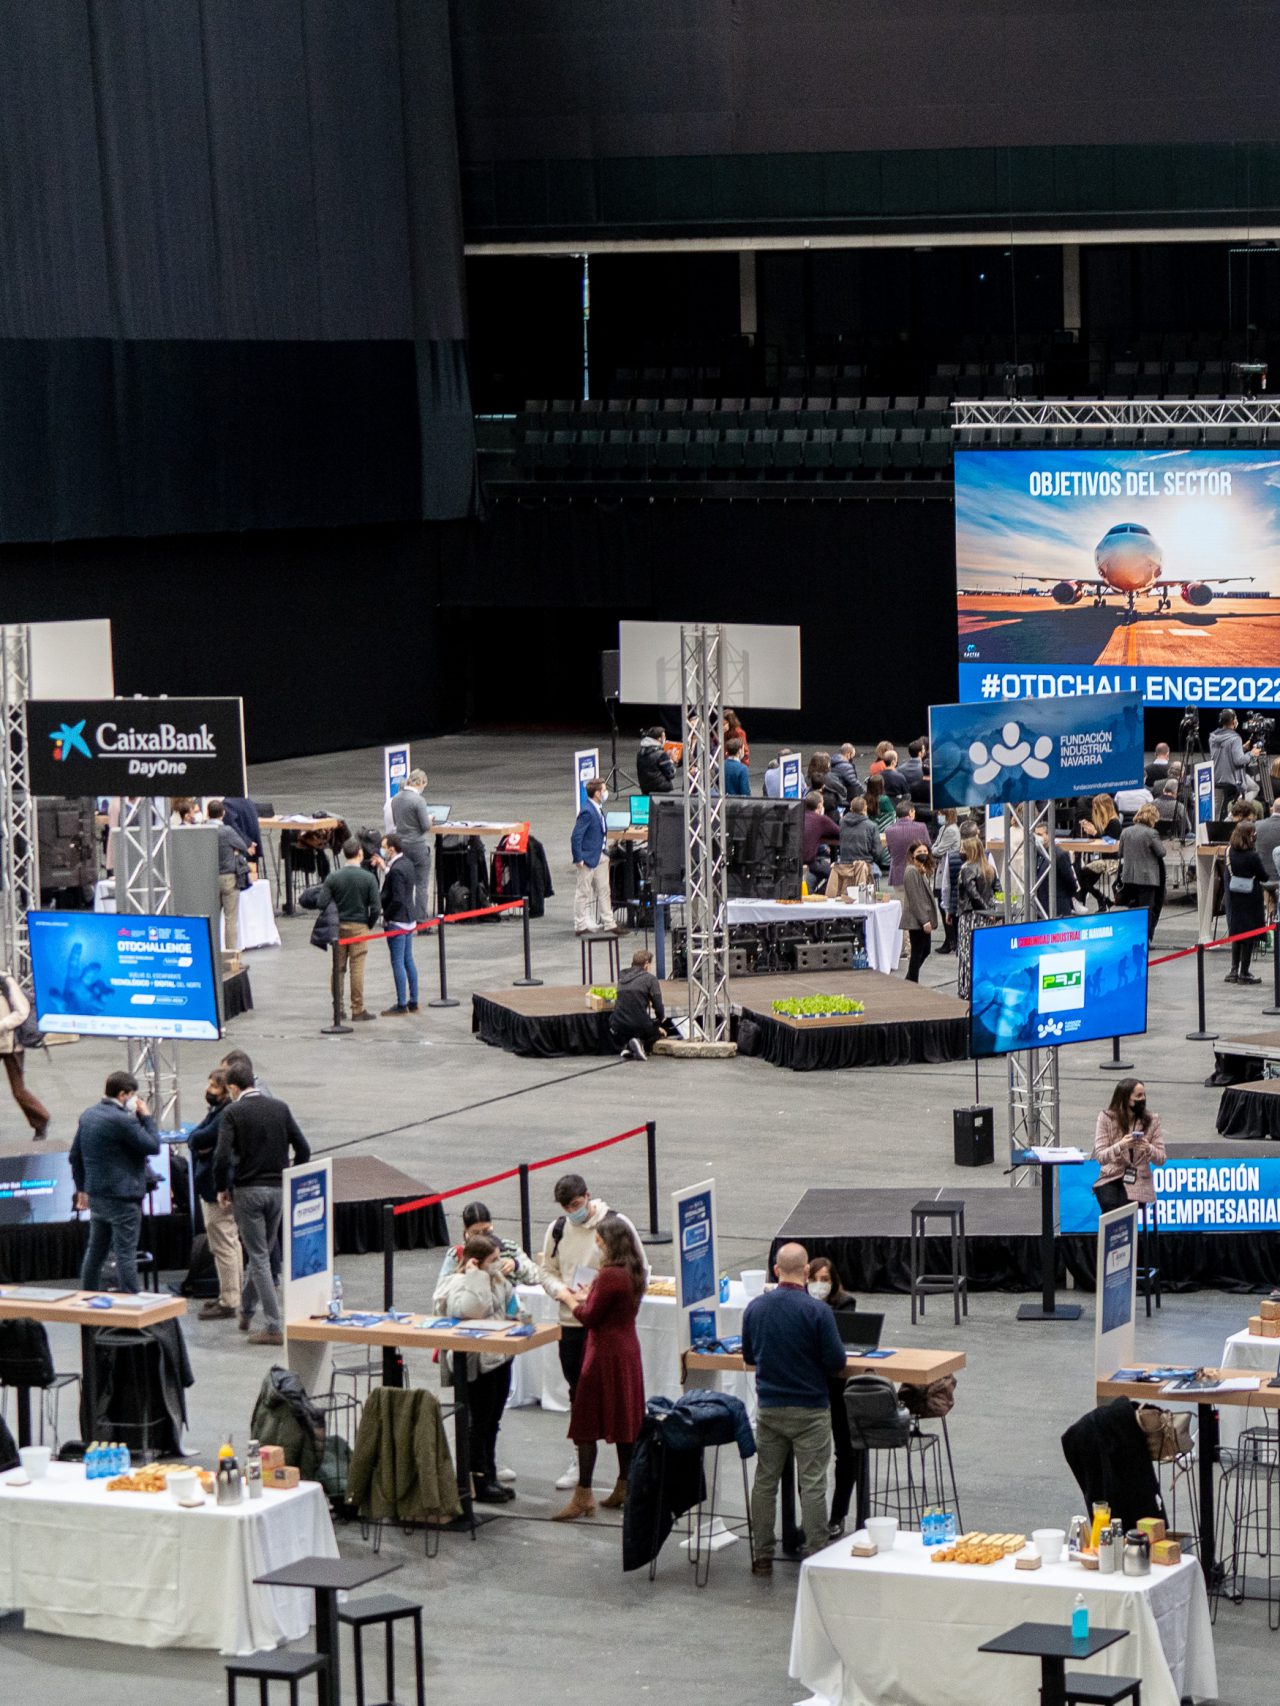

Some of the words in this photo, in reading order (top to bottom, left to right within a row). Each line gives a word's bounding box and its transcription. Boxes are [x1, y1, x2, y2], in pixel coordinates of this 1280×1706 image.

[1029, 471, 1122, 496] OBJETIVOS
[1126, 472, 1160, 496] DEL
[1164, 471, 1232, 496] SECTOR
[96, 722, 216, 751] CaixaBank
[1060, 730, 1112, 746] FUNDACIÓN
[1060, 742, 1112, 756] INDUSTRIAL
[128, 759, 187, 778] DayOne
[1060, 754, 1103, 768] NAVARRA
[1010, 937, 1018, 949] LA
[1153, 1163, 1259, 1192] OOPERACIÓN
